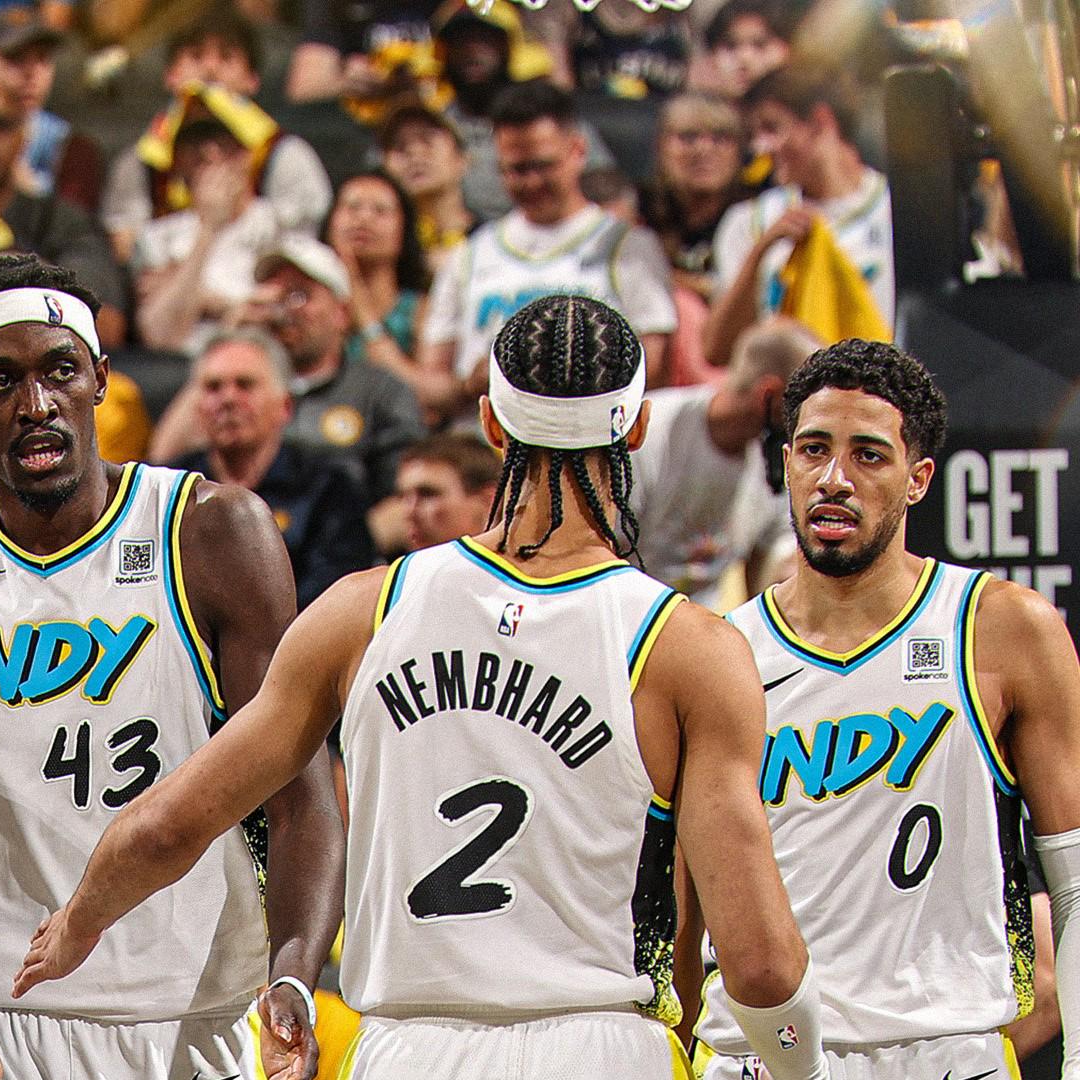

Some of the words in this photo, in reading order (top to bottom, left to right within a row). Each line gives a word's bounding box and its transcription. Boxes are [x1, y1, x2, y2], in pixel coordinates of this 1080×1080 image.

[944, 449, 1069, 560] GET
[42, 718, 161, 808] 43
[376, 649, 613, 770] NEMBHARD
[407, 778, 529, 919] 2
[888, 803, 942, 890] 0
